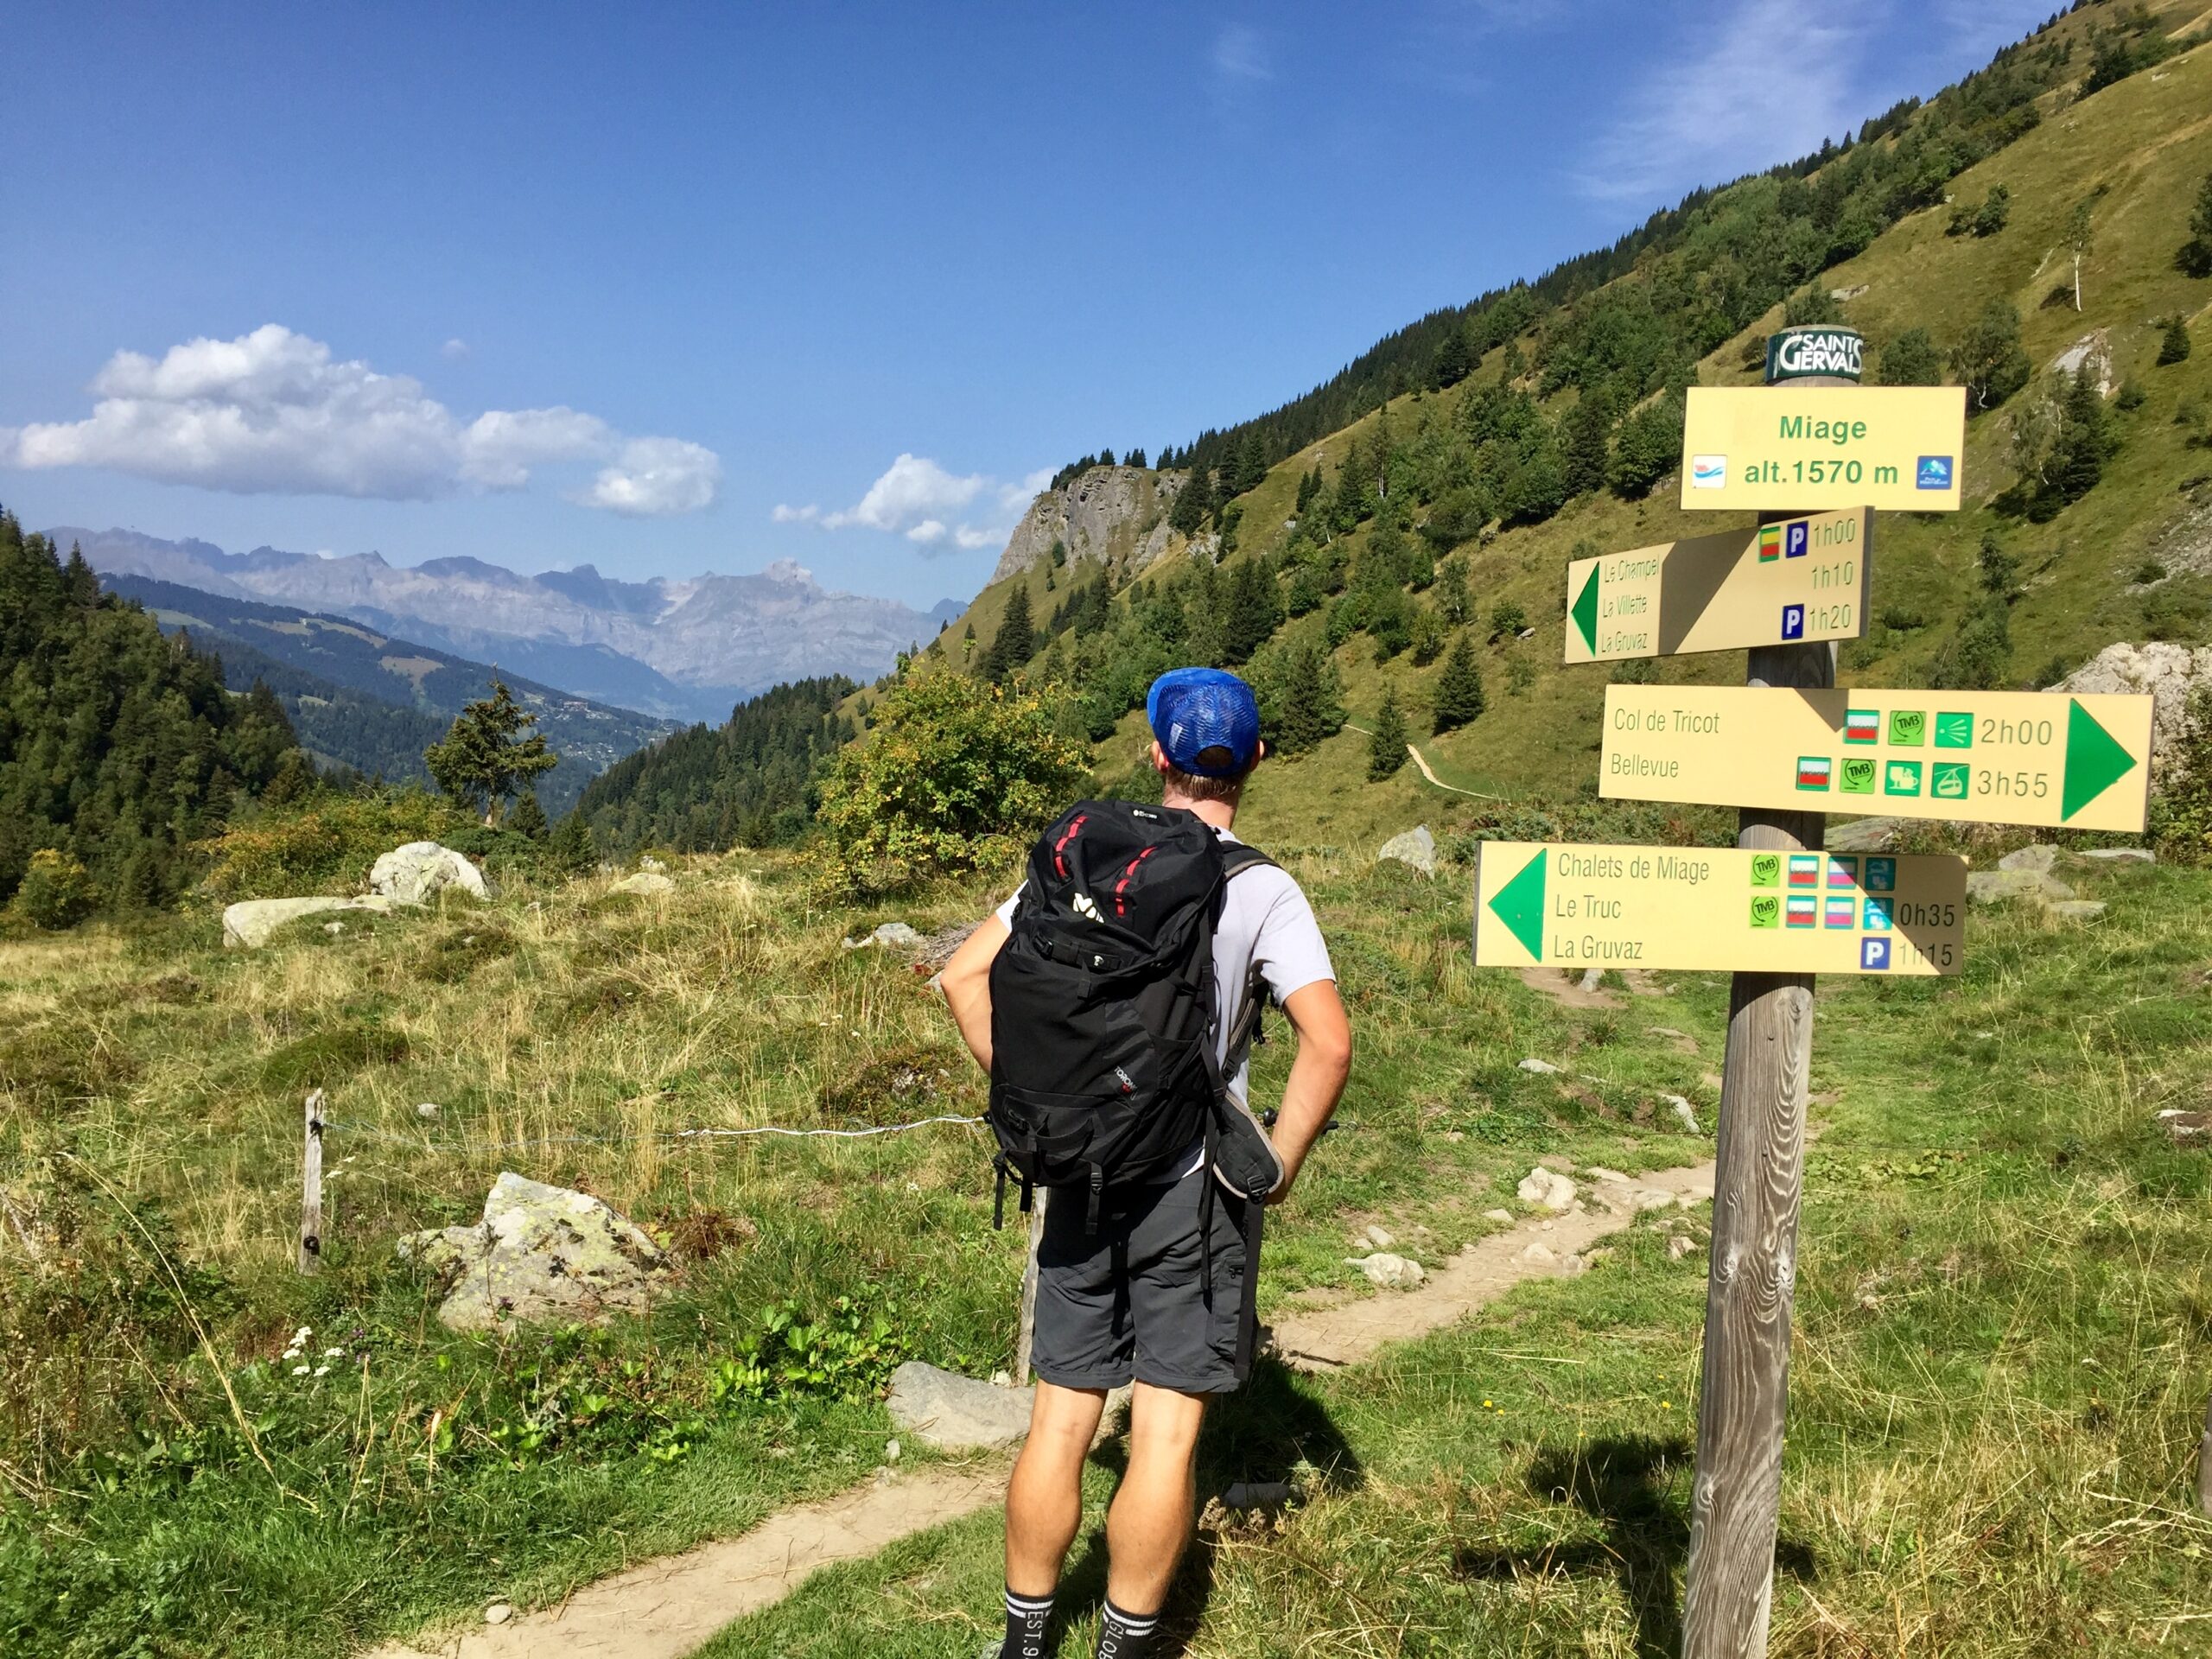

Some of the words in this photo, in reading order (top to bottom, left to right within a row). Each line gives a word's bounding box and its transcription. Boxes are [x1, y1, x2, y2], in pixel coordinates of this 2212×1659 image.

[1779, 416, 1867, 445] Miage
[1745, 460, 1863, 484] alt.1570
[1874, 466, 1898, 484] m
[1790, 527, 1805, 553] P
[1814, 518, 1855, 547] 1h00
[1605, 563, 1616, 583] Le
[1618, 554, 1660, 582] Champel
[1812, 561, 1853, 589] 1h10
[1603, 598, 1614, 618] La
[1617, 594, 1647, 615] Villette
[1786, 609, 1801, 634] P
[1809, 604, 1852, 631] 1h20
[1601, 633, 1612, 652] La
[1614, 630, 1648, 652] Gruvaz
[1615, 708, 1641, 730] Col
[1646, 709, 1666, 732] de
[1673, 710, 1720, 734] Tricot
[1897, 715, 1920, 729] TMB
[1980, 719, 2053, 746] 2h00
[1611, 753, 1679, 778] Bellevue
[1847, 763, 1871, 777] TMB
[1978, 770, 2048, 798] 3h55
[1558, 852, 1624, 878] Chalets
[1630, 855, 1650, 879] de
[1657, 855, 1710, 886] Miage
[1755, 858, 1777, 873] TMB
[1556, 893, 1577, 918] Le
[1583, 894, 1622, 918] Truc
[1754, 899, 1776, 914] TMB
[1899, 903, 1955, 927] 0h35
[1554, 934, 1575, 959] La
[1581, 935, 1643, 960] Gruvaz
[1866, 941, 1885, 966] P
[1899, 943, 1953, 967] 1h15
[1022, 1611, 1044, 1659] EST.9
